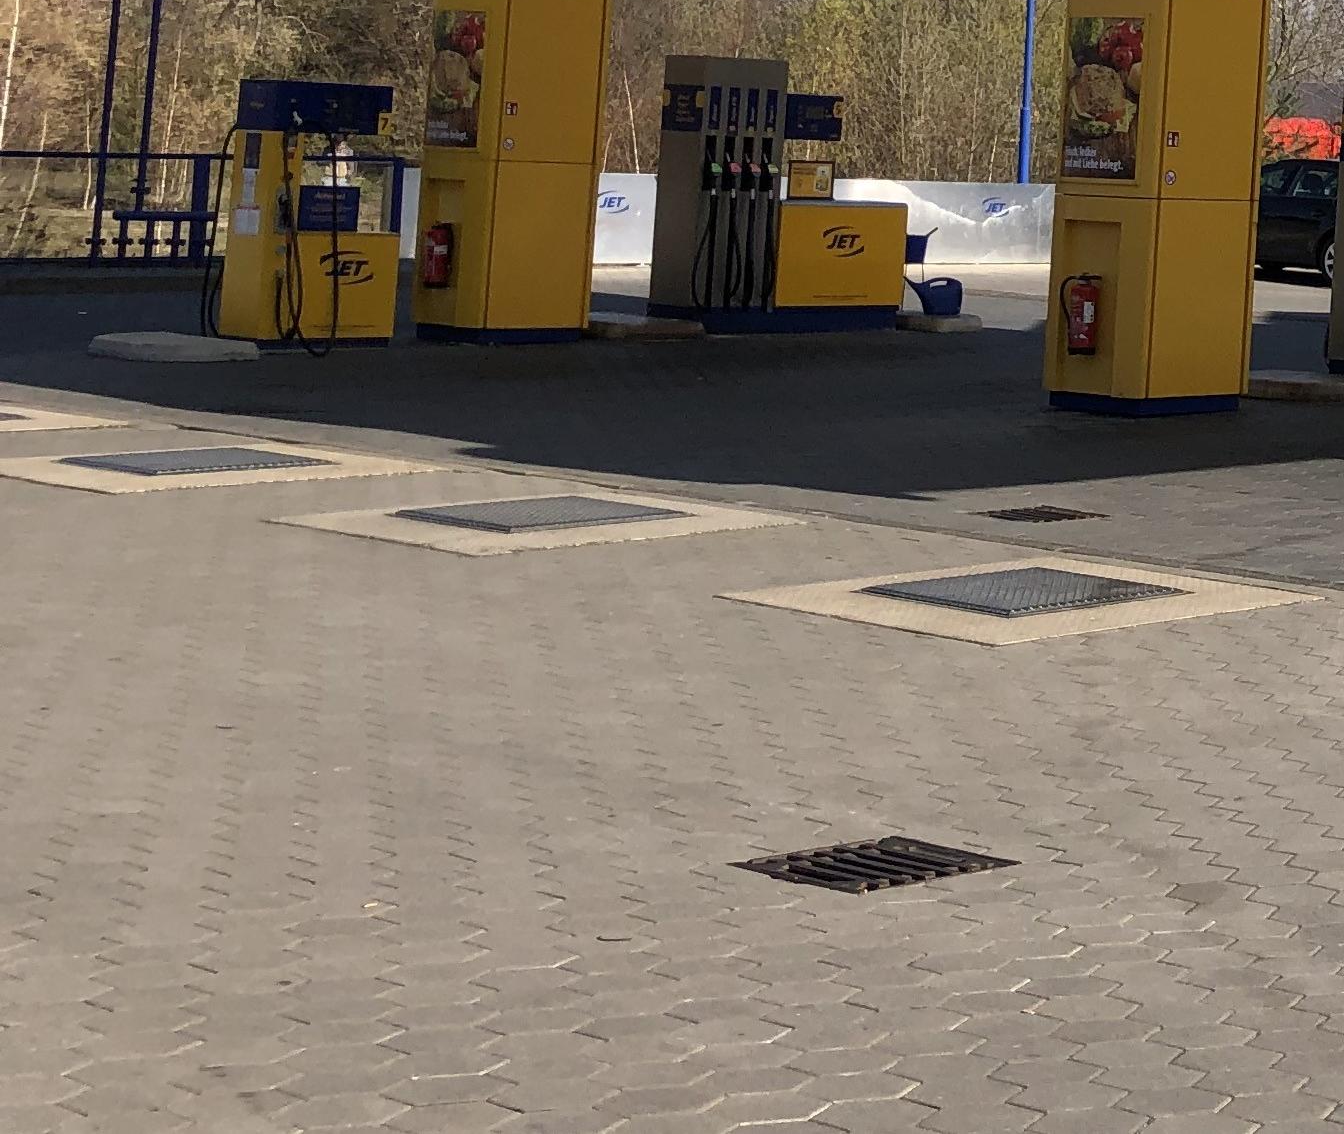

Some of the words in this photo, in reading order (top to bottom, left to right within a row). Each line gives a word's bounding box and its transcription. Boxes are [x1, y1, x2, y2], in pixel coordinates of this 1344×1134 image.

[599, 197, 626, 208] JET
[985, 202, 1006, 212] JET
[826, 234, 861, 250] JET
